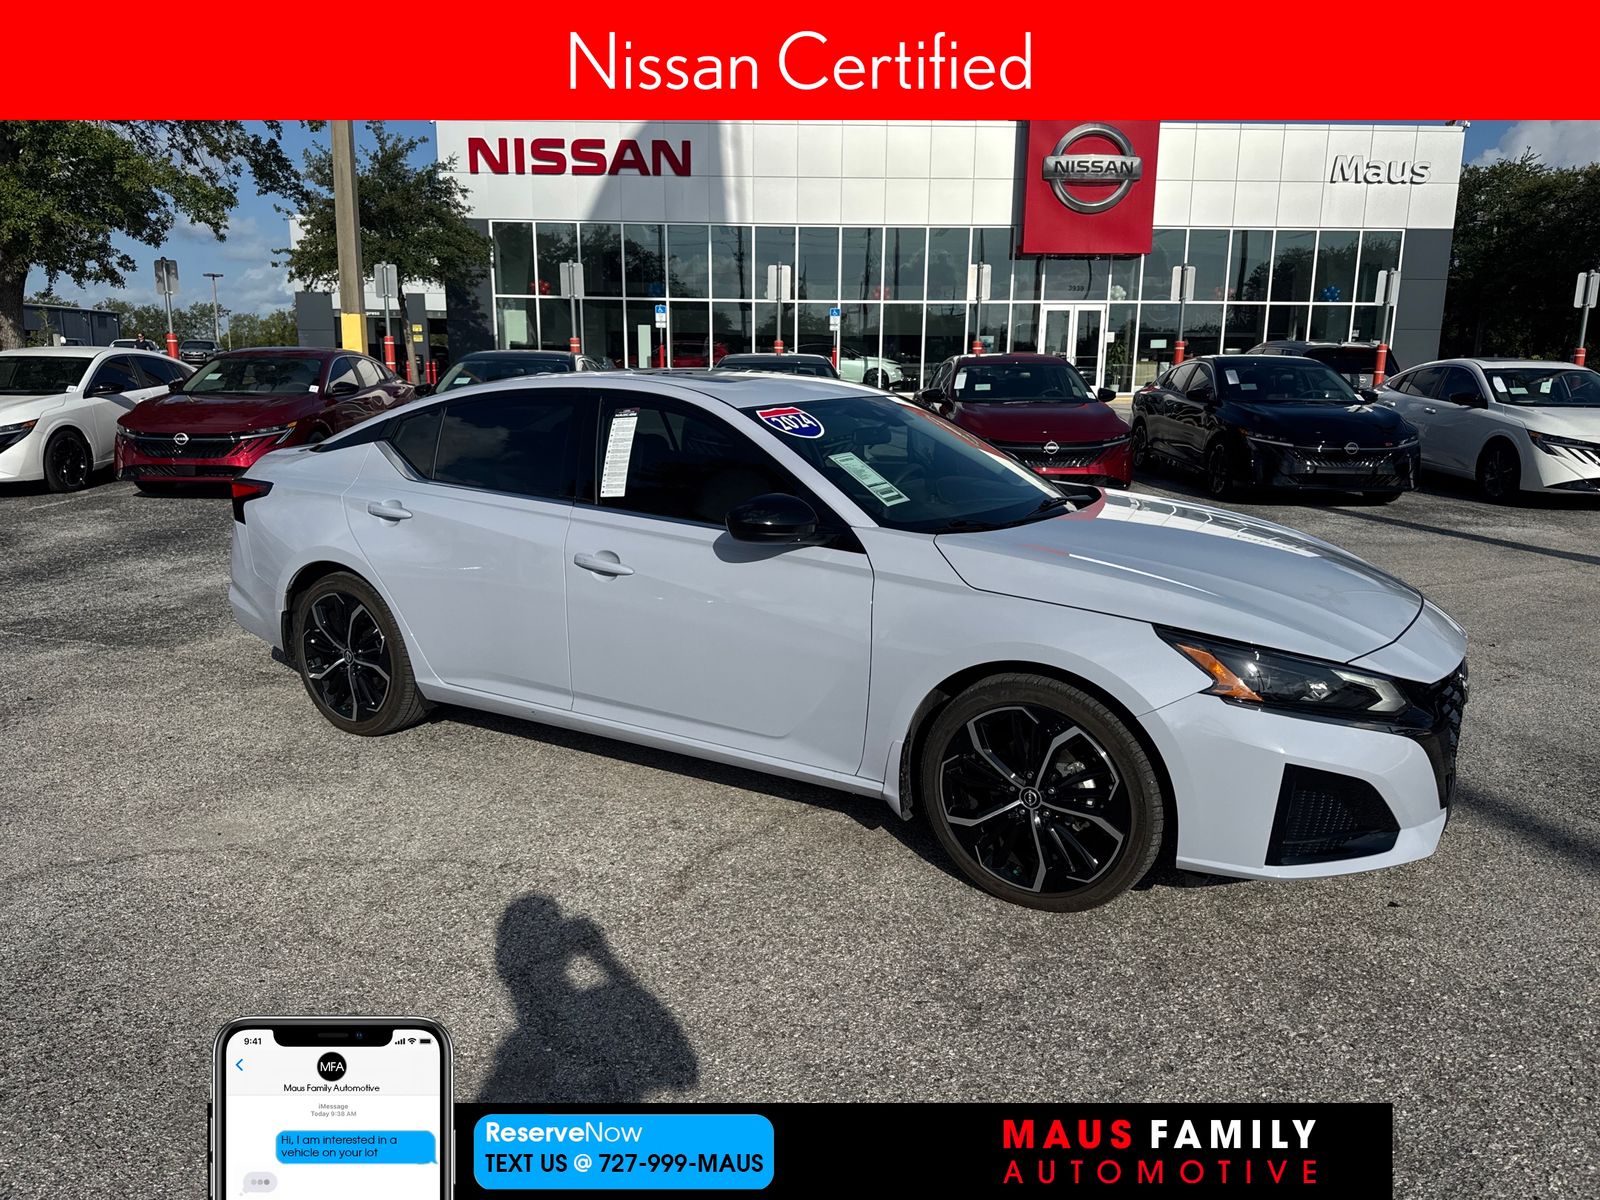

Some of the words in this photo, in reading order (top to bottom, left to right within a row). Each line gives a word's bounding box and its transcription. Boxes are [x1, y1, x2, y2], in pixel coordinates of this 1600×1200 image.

[467, 136, 692, 177] NISSAN
[1053, 159, 1134, 175] NISSAN
[1329, 154, 1432, 186] Maus
[771, 413, 815, 431] 2024
